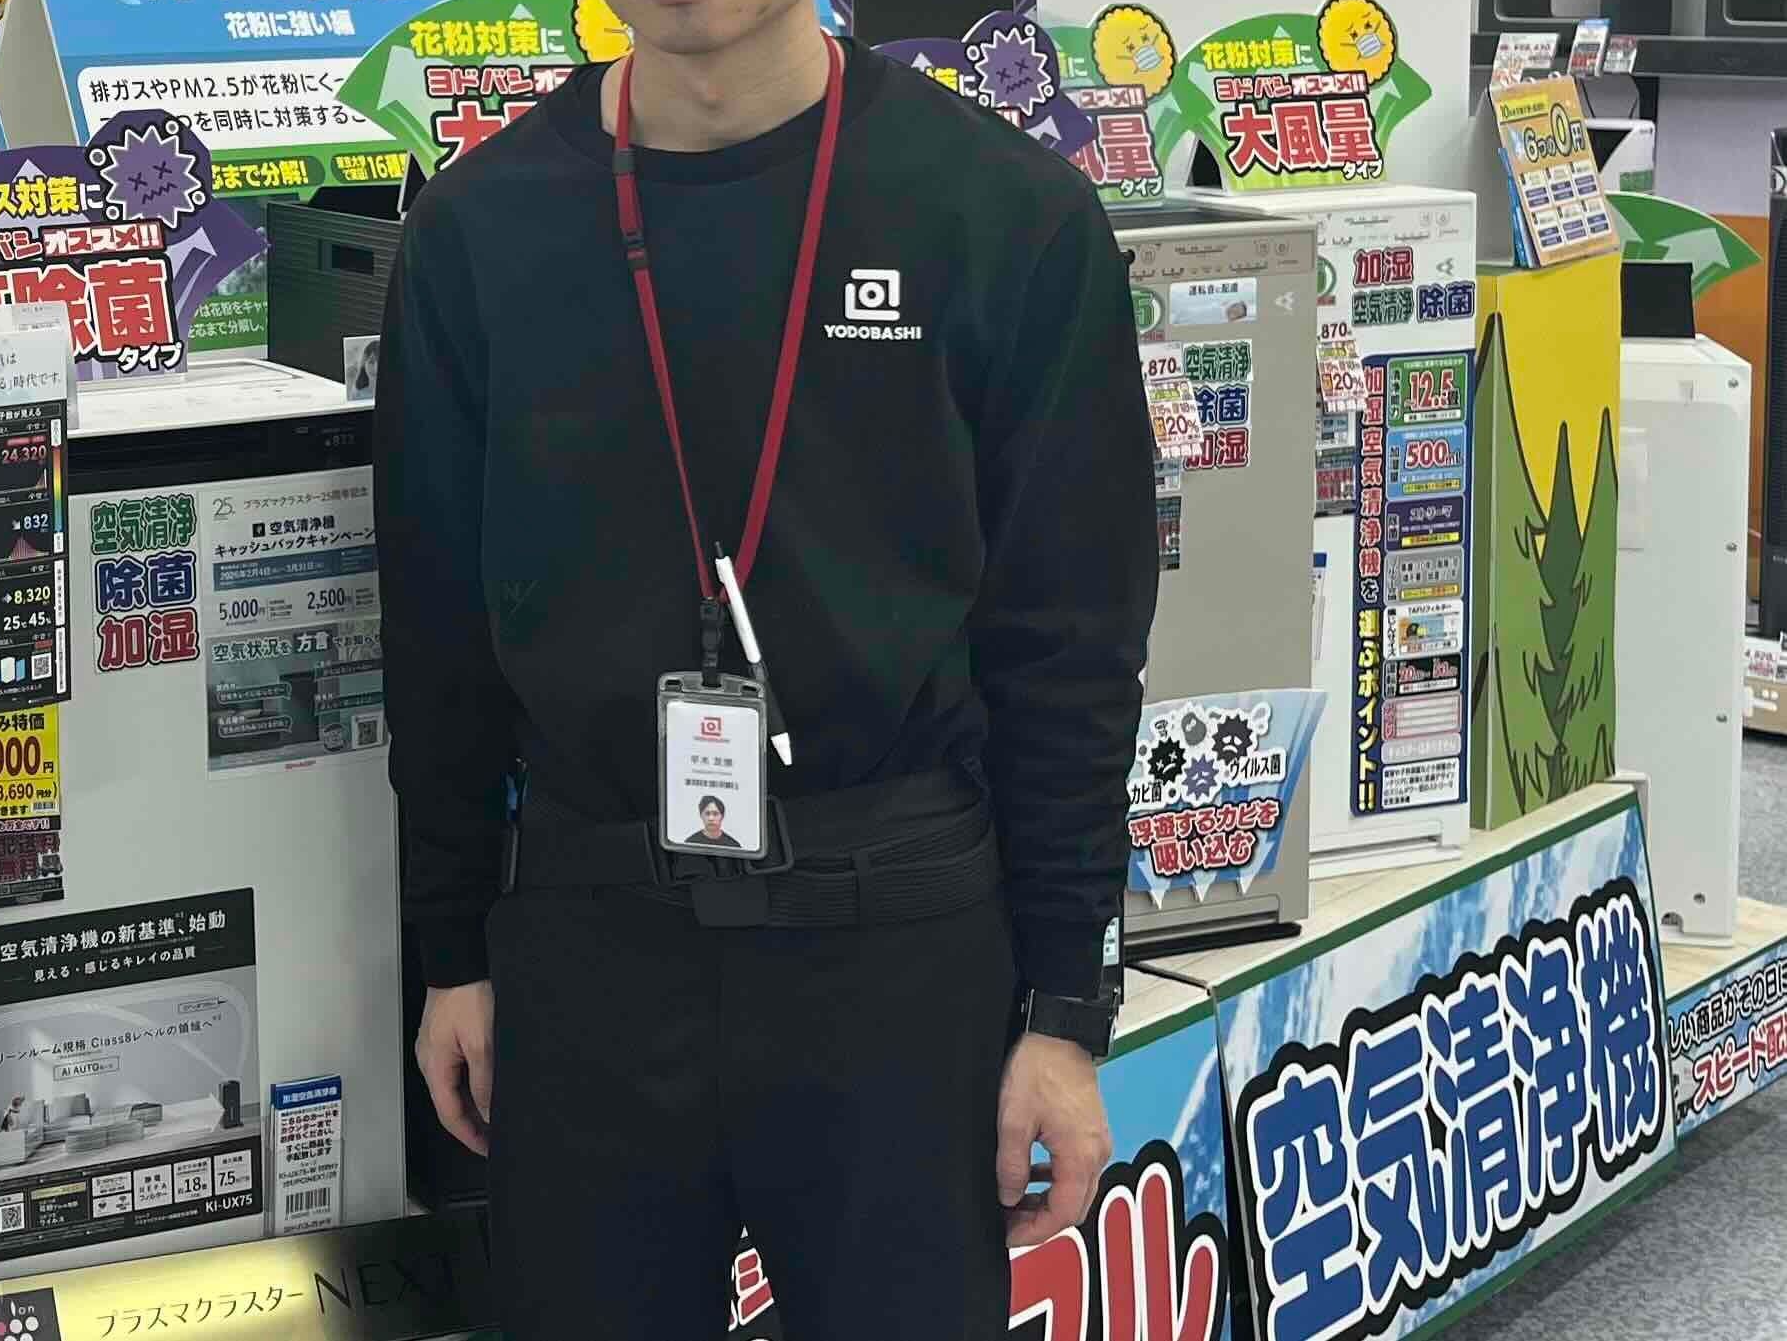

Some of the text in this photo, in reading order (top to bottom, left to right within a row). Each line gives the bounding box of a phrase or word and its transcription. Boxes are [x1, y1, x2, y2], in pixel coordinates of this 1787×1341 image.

[224, 9, 356, 40] 花粉に強い編
[408, 20, 566, 57] 花粉対策に
[1201, 35, 1313, 71] 花粉対策に
[1214, 72, 1370, 101] ヨドバシオススメ!!
[1225, 100, 1381, 175] 大風量
[1118, 175, 1165, 199] タイプ
[1341, 157, 1384, 181] タイプ
[1352, 246, 1414, 287] 加湿
[1351, 289, 1414, 325] 空気清浄
[1416, 282, 1477, 322] 除菌
[823, 323, 923, 342] YODOBASHI
[116, 341, 185, 372] タイプ
[1184, 341, 1251, 381] 空気清浄
[23, 513, 49, 530] 832
[90, 493, 198, 555] 空気清浄
[269, 515, 336, 537] 空気清浄機
[96, 552, 197, 612] 除菌
[97, 611, 200, 671] 加湿
[1228, 754, 1285, 782] ウイルス菌
[1131, 780, 1164, 806] カビ菌
[1128, 798, 1279, 846] 浮遊するカビを
[1152, 832, 1256, 878] 吸い込む
[33, 944, 198, 984] 見える・感じるキレイの品質
[1244, 893, 1659, 1341] 空気清浄機
[204, 1193, 254, 1216] KI-UX75
[96, 1286, 305, 1340] プラズマクラスター
